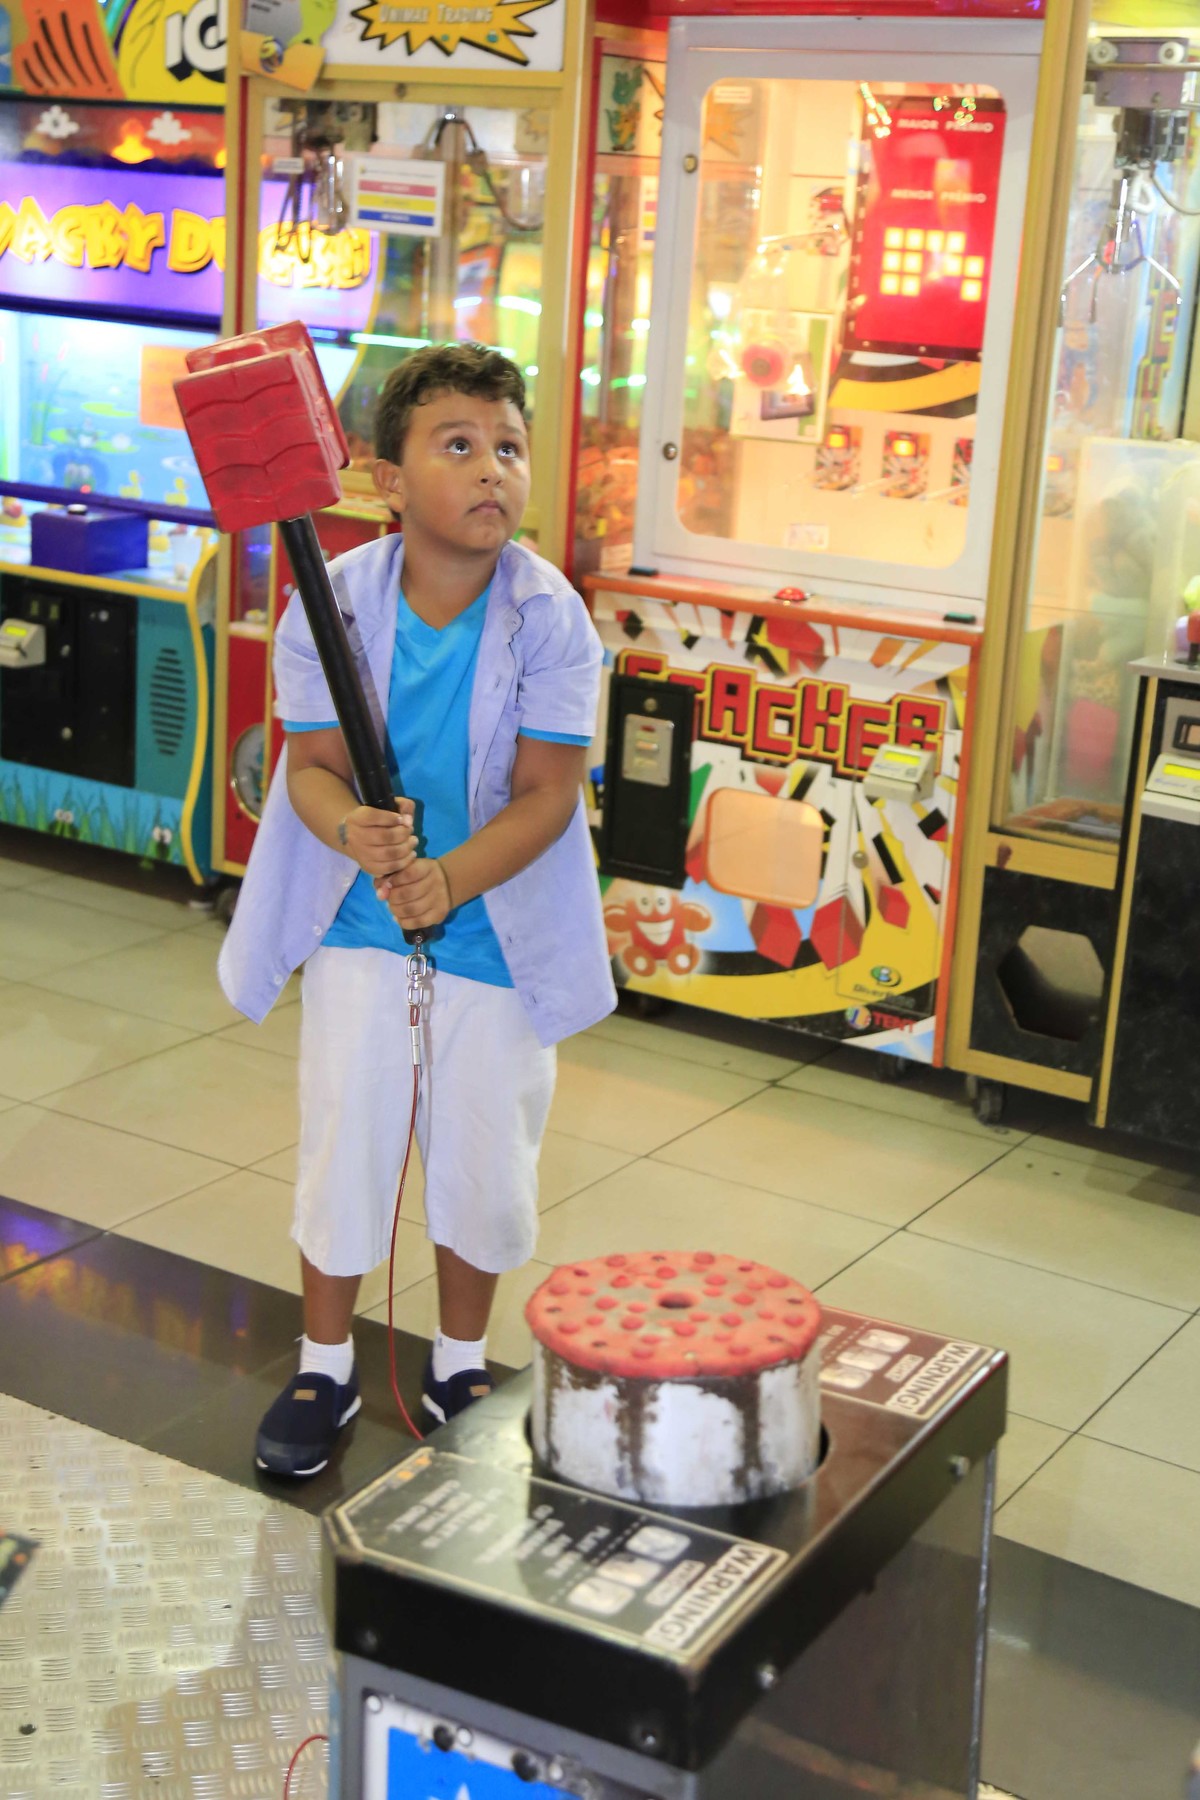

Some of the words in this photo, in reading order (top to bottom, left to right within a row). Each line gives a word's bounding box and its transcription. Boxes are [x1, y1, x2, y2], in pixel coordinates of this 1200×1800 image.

[0, 196, 165, 273] ACKY
[888, 1343, 975, 1412] WARNING!
[649, 1545, 763, 1645] WARNING!
